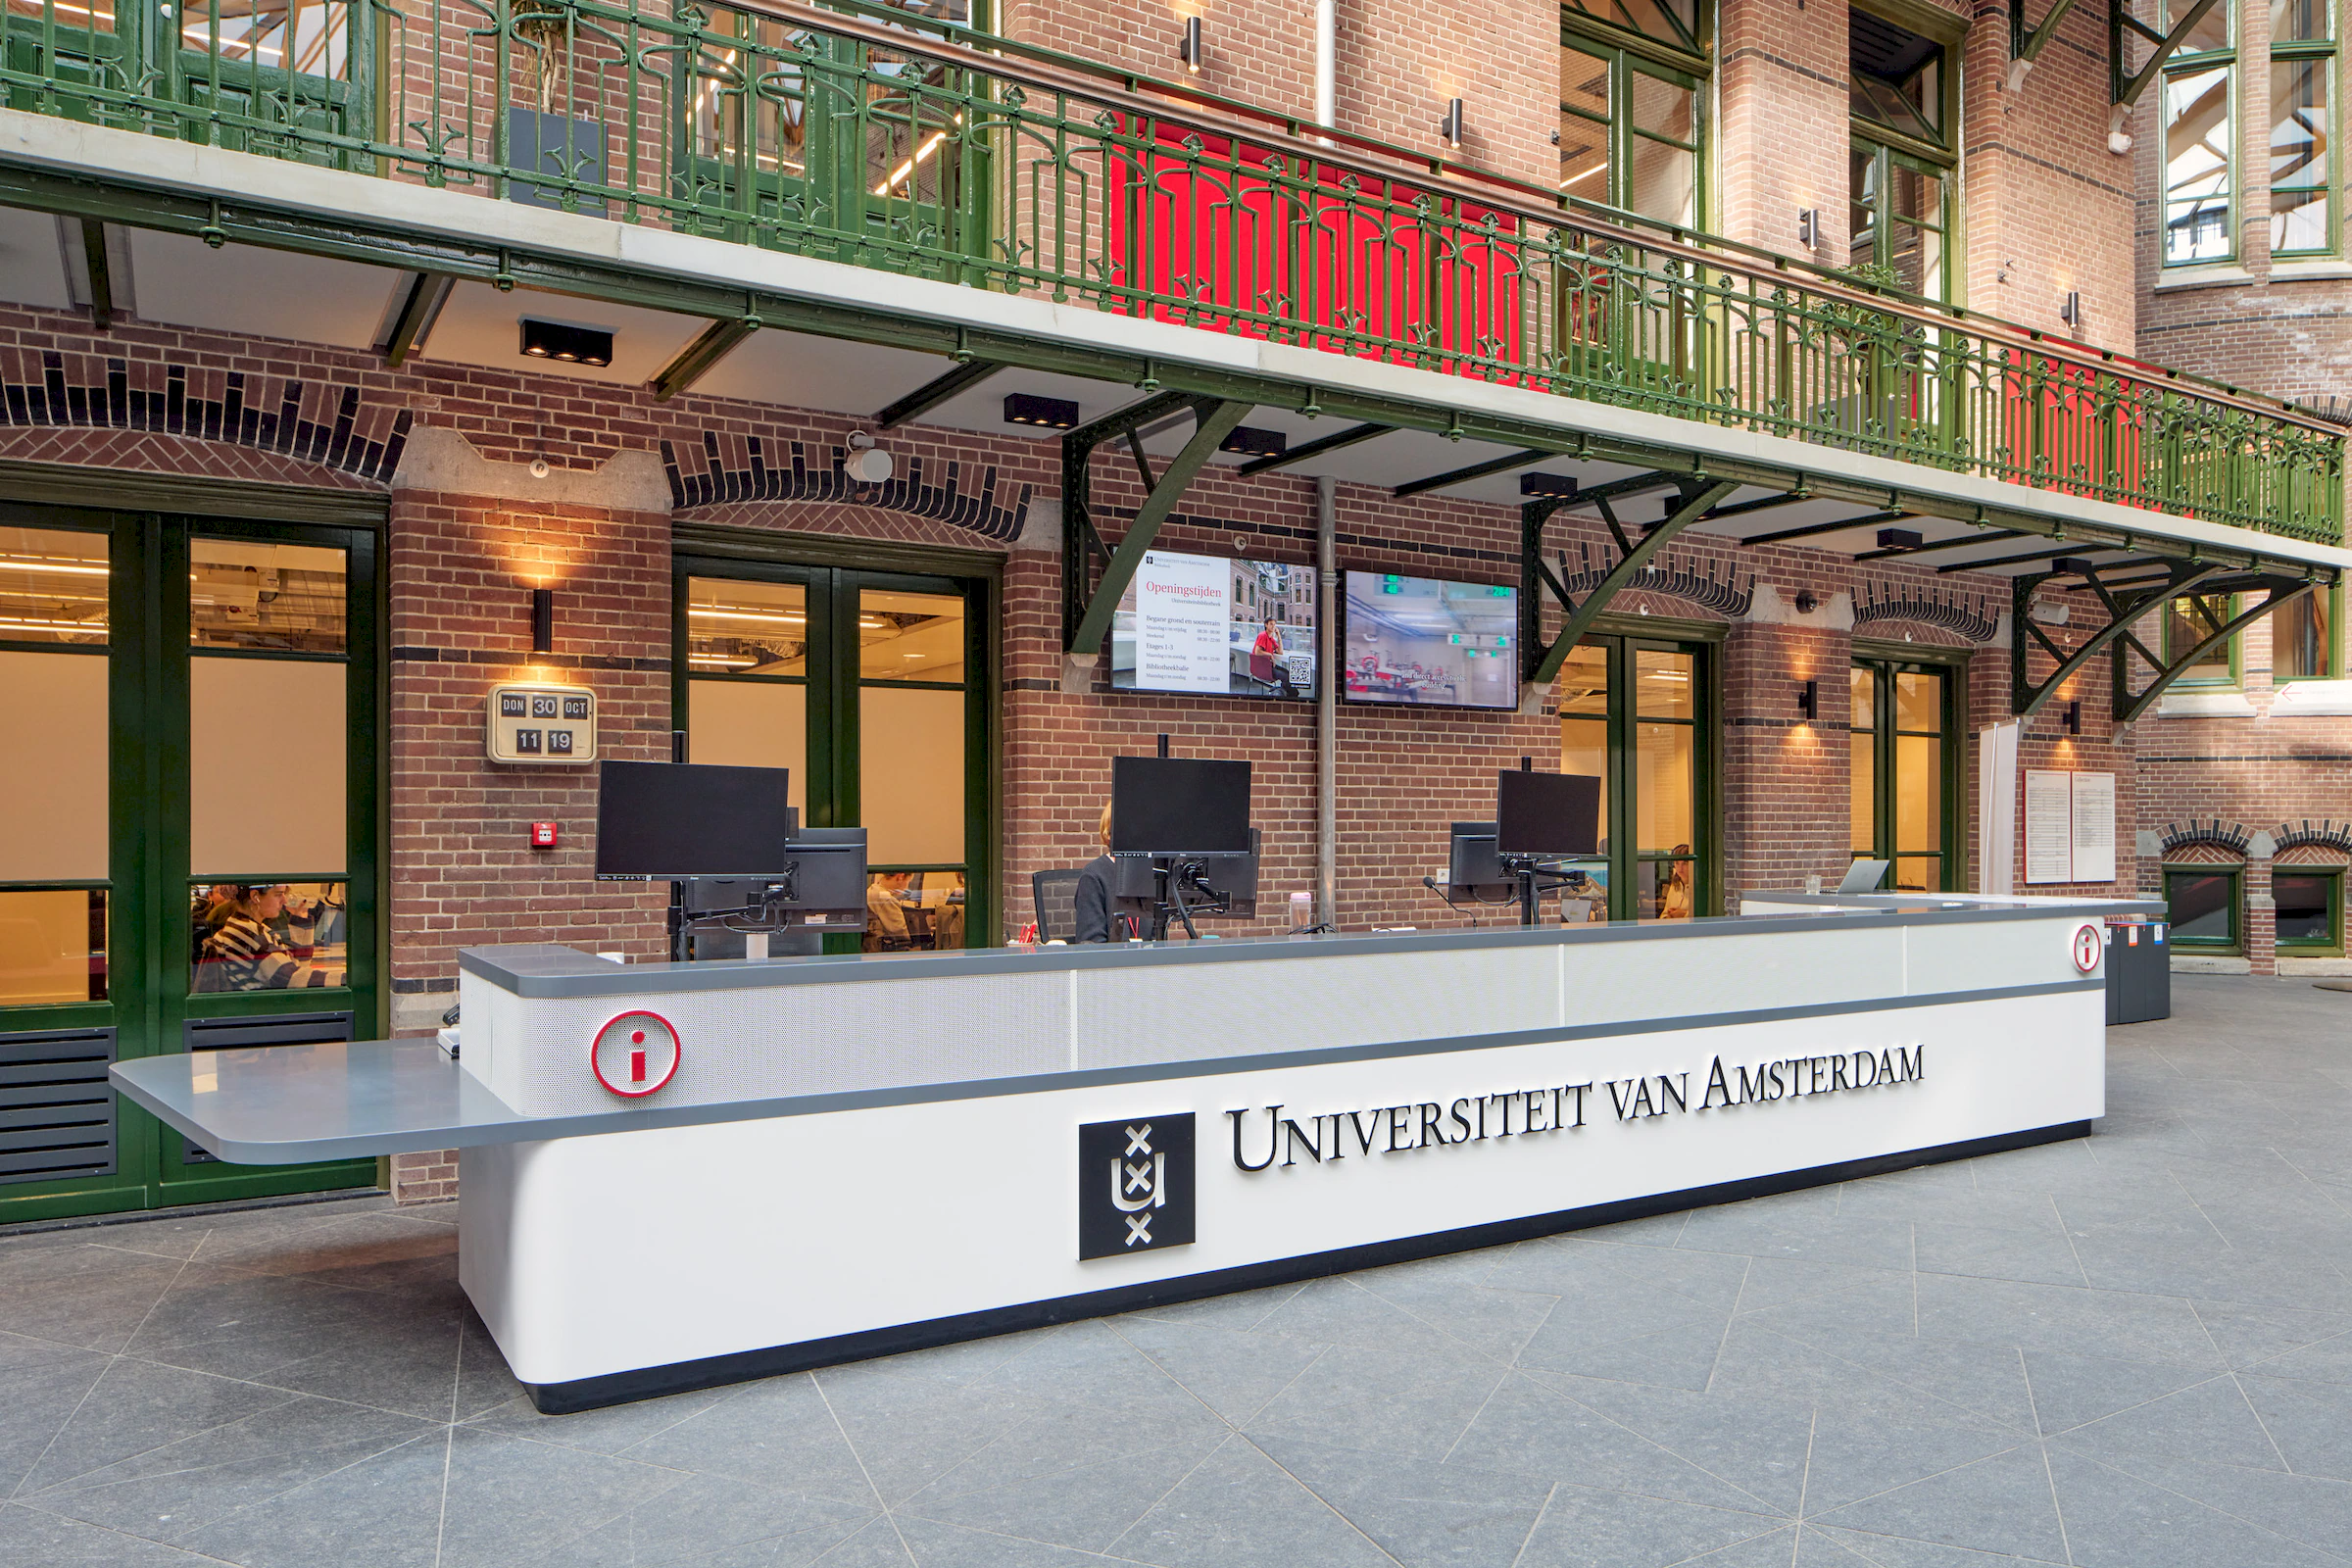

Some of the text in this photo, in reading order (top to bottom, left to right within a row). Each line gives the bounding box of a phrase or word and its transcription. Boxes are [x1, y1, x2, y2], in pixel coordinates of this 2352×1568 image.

[1146, 581, 1221, 599] Openingstijden
[1171, 598, 1221, 607] Universiteitsbibliotheek
[1146, 663, 1189, 671] Bibliotheekbalie
[503, 699, 586, 714] DON 30 OCT
[520, 733, 570, 748] 11 19
